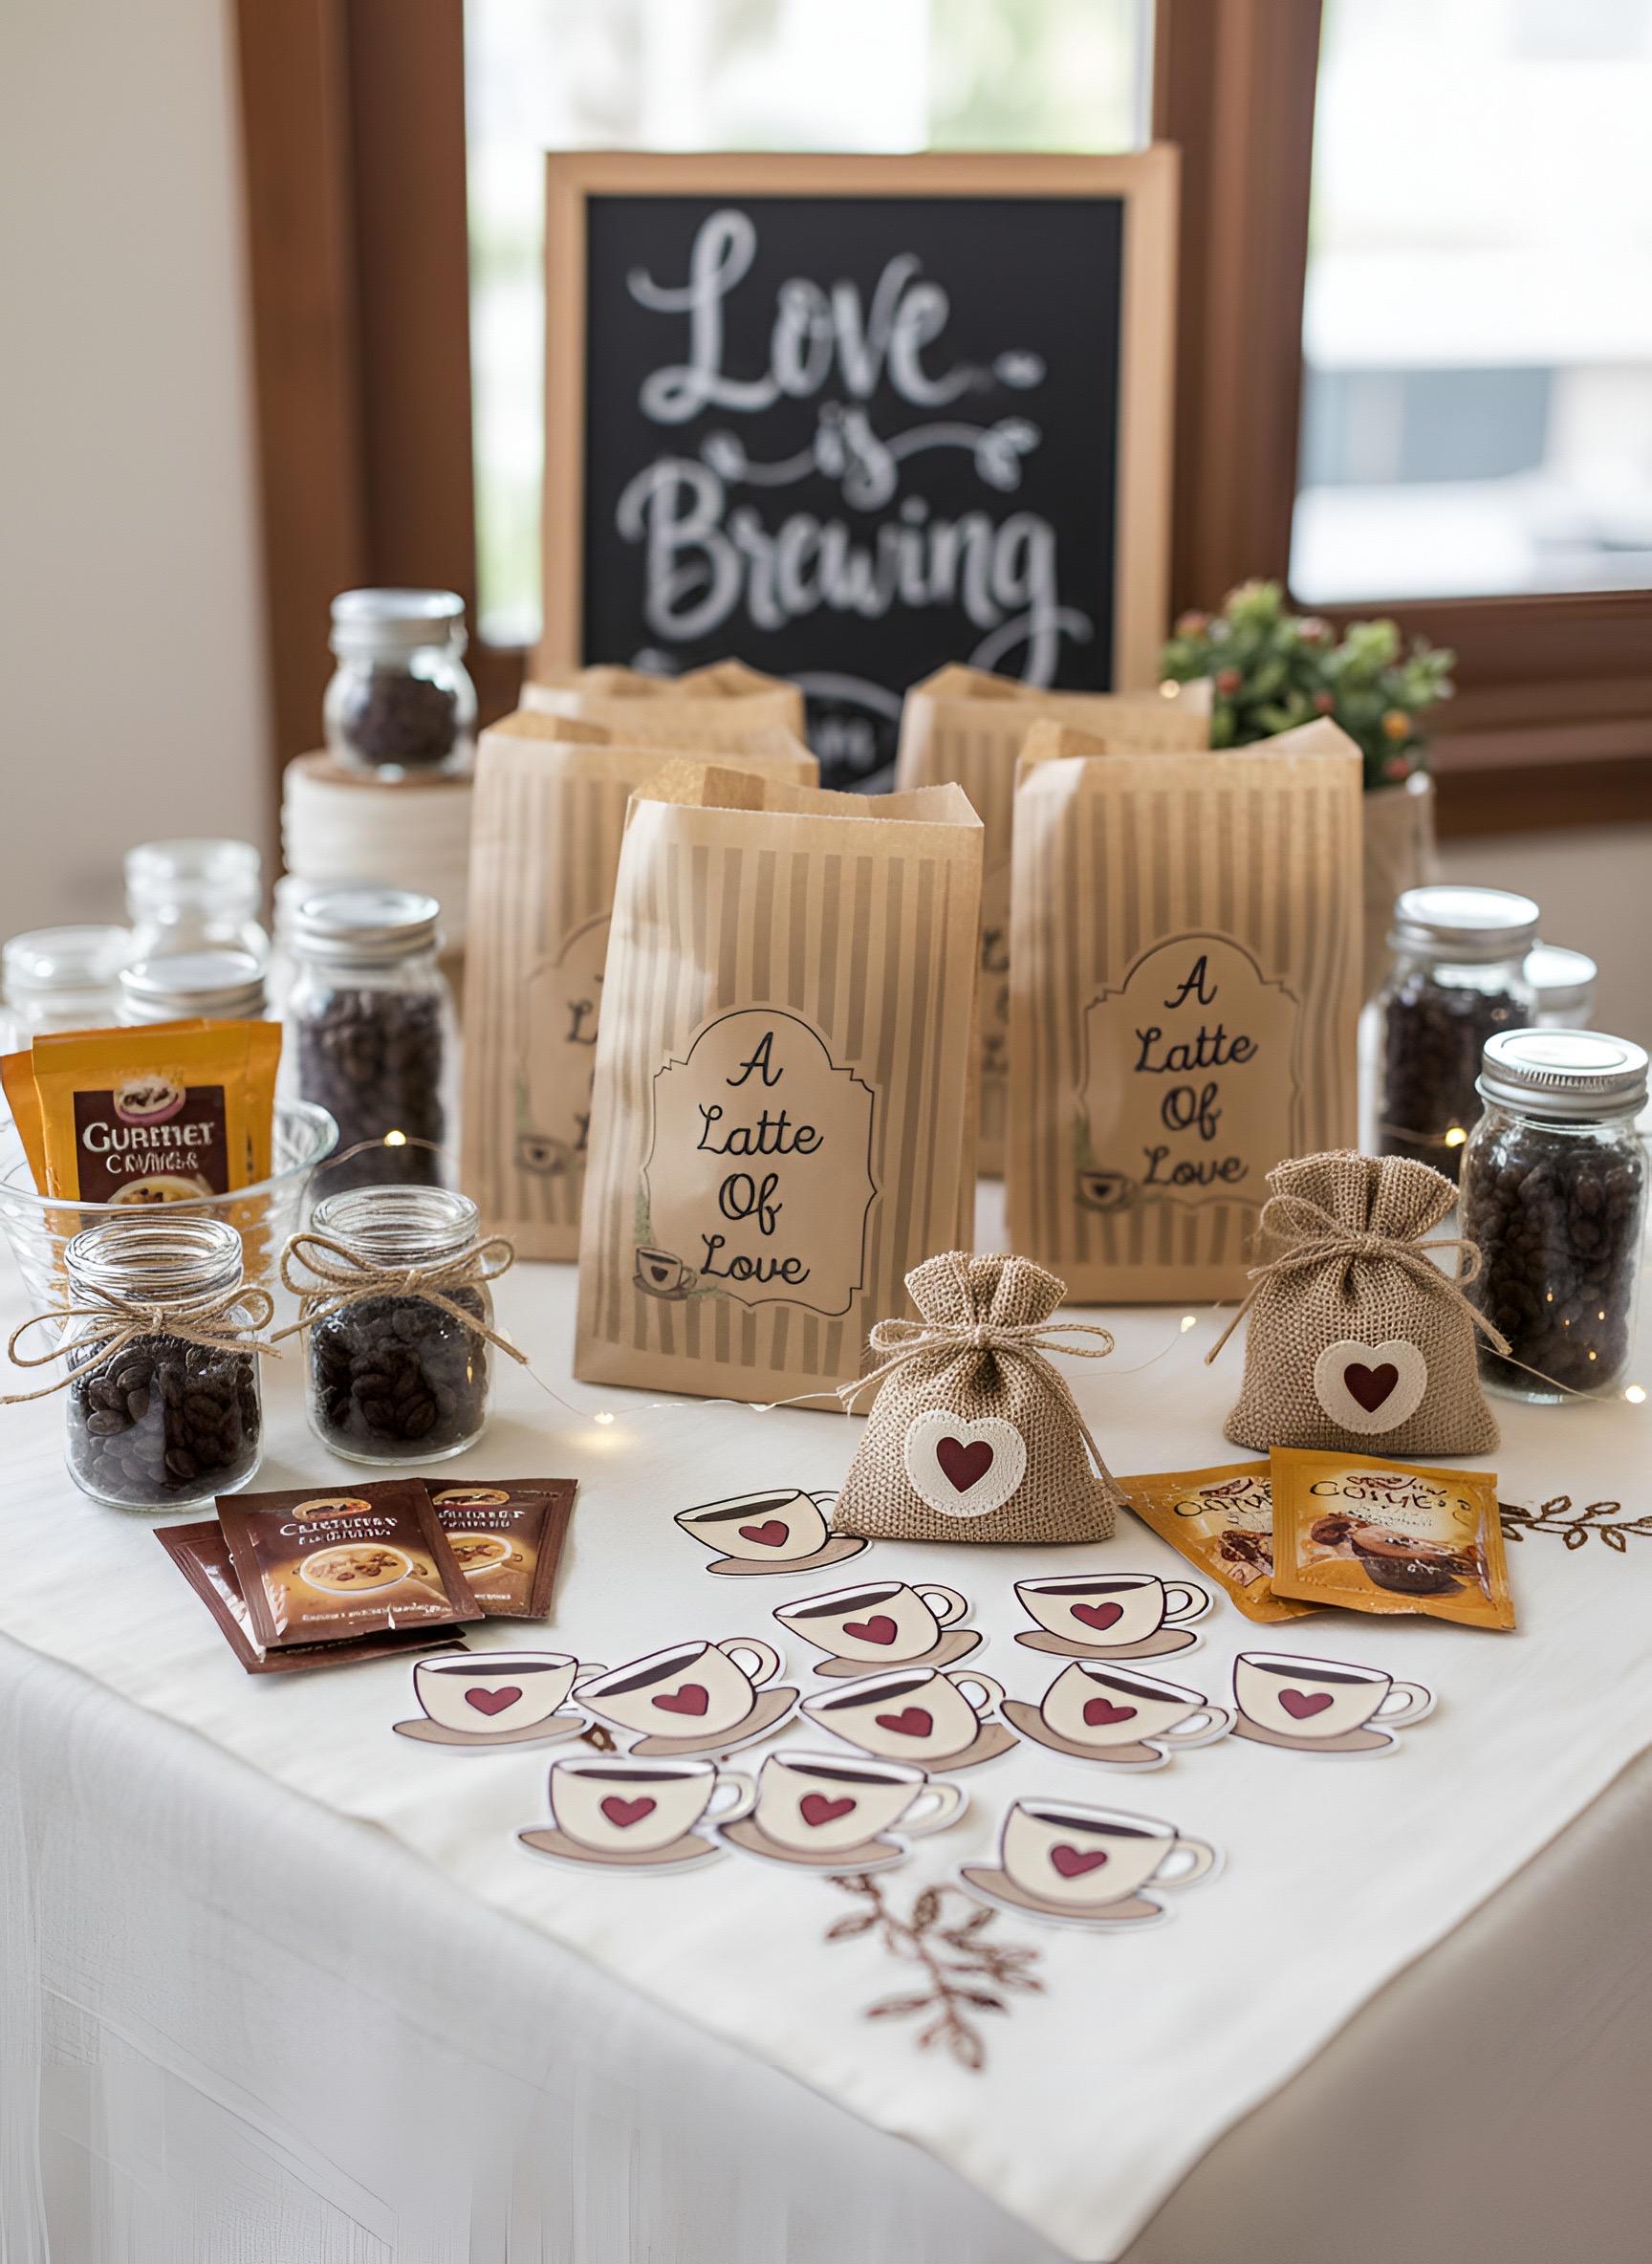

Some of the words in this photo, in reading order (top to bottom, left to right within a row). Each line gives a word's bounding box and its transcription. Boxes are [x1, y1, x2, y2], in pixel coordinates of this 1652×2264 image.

[626, 208, 967, 424] Love
[813, 400, 897, 512] is
[617, 457, 1093, 687] Brewing
[1163, 954, 1218, 1009] A
[726, 1031, 784, 1087] A
[1134, 1023, 1259, 1073] Latte
[696, 1103, 824, 1156] Latte
[1162, 1081, 1222, 1142] Of
[1141, 1145, 1248, 1186] Love
[718, 1172, 783, 1236] Of
[700, 1233, 811, 1285] Love
